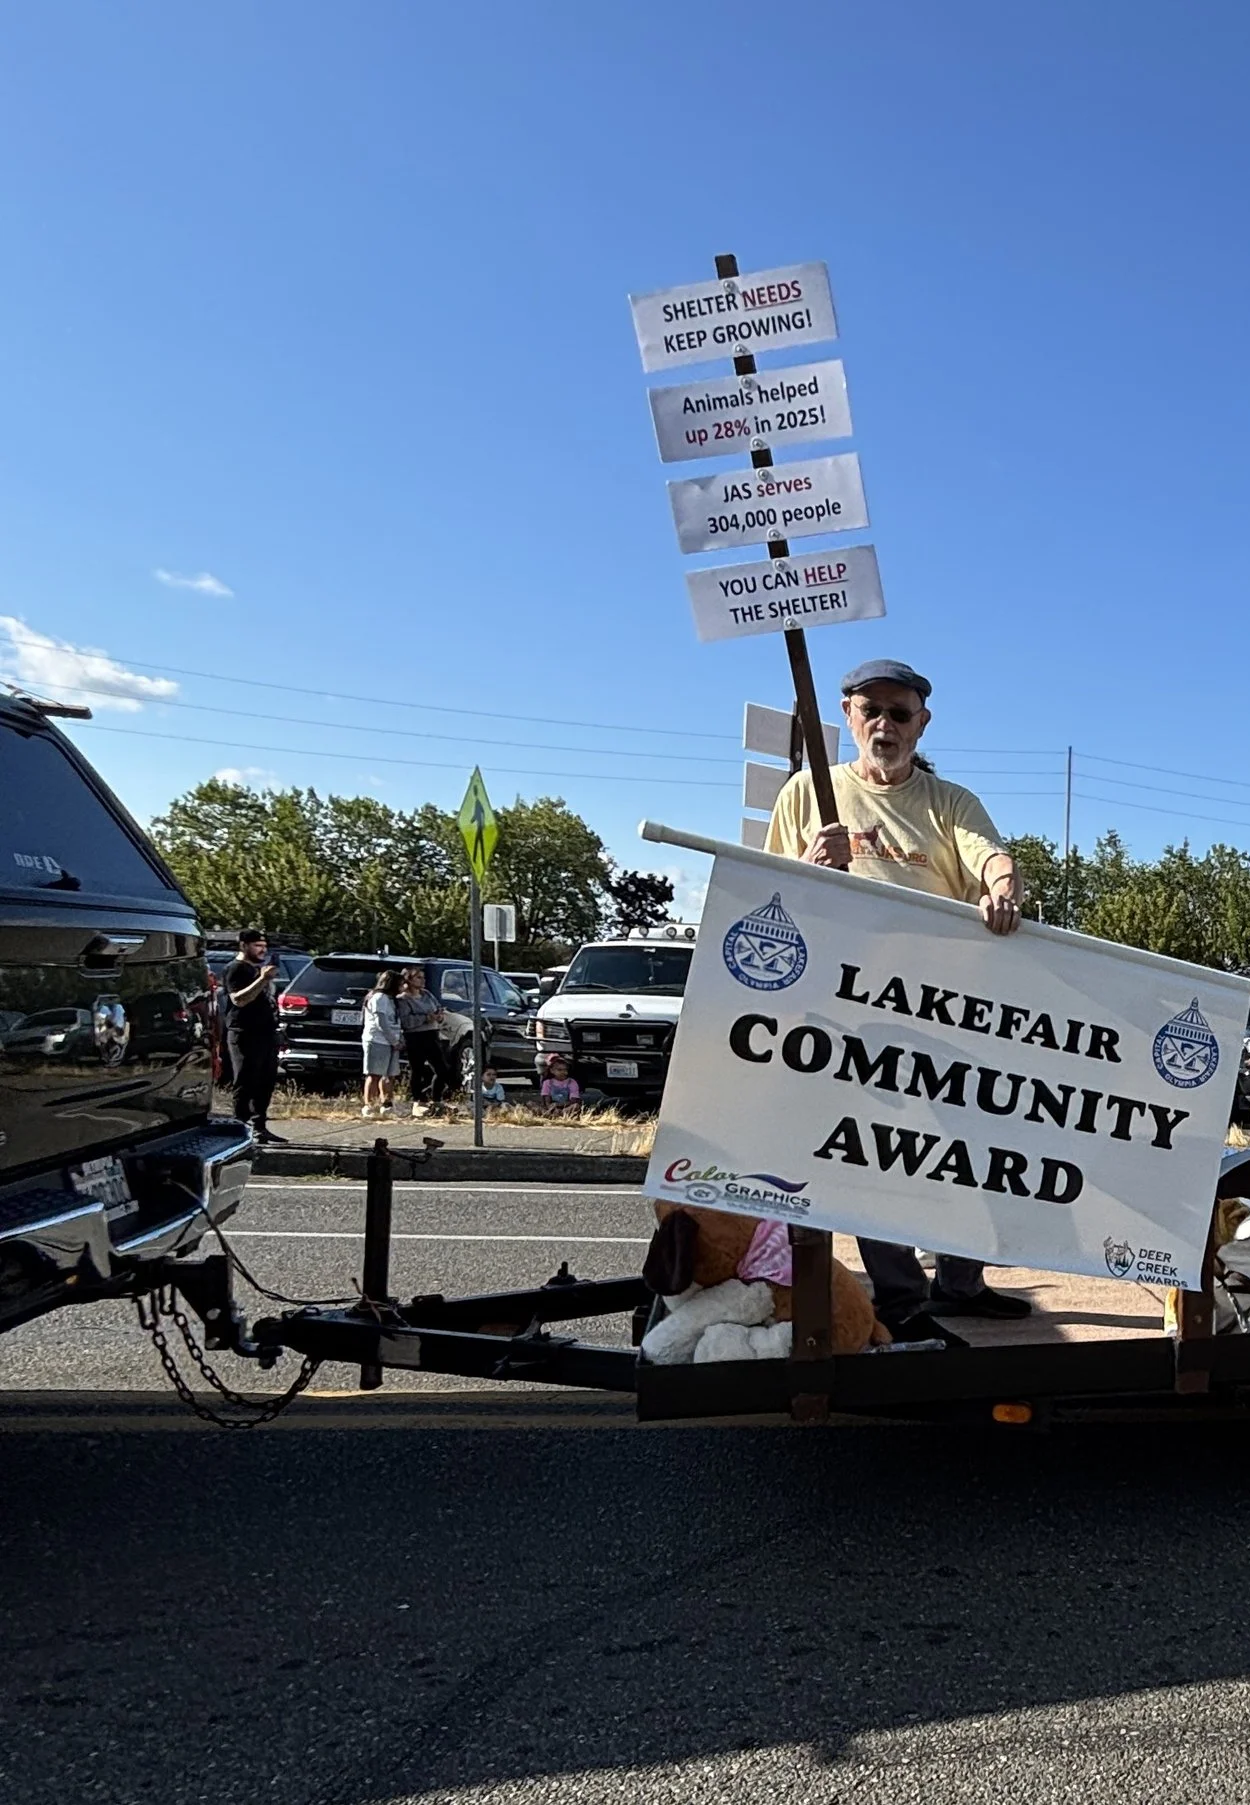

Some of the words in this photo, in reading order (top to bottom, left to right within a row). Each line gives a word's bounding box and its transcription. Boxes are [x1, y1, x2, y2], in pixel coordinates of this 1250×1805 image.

[662, 291, 737, 323] SHELTER
[742, 280, 802, 310] NEEDS
[664, 330, 708, 354] KEEP
[712, 307, 813, 344] GROWING!
[682, 387, 754, 414] Animals
[757, 376, 819, 408] helped
[685, 426, 708, 447] up
[712, 418, 751, 440] 28%
[755, 415, 772, 434] in
[775, 404, 827, 431] 2025!
[723, 481, 752, 503] JAS
[756, 475, 812, 498] serves
[707, 507, 777, 534] 304,000
[781, 499, 842, 528] people
[719, 575, 757, 598] YOU
[762, 569, 799, 591] CAN
[804, 562, 848, 586] HELP
[729, 604, 764, 625] THE
[768, 590, 848, 618] SHELTER!
[834, 962, 1122, 1064] LAKEFAIR
[728, 1012, 1190, 1152] COMMUNITY
[664, 1158, 740, 1183] Color
[812, 1115, 1085, 1206] AWARD
[725, 1183, 811, 1208] GRAPHICS
[1136, 1261, 1178, 1277] CREEK
[1138, 1248, 1172, 1263] DEER
[1136, 1274, 1188, 1288] AWARDS
